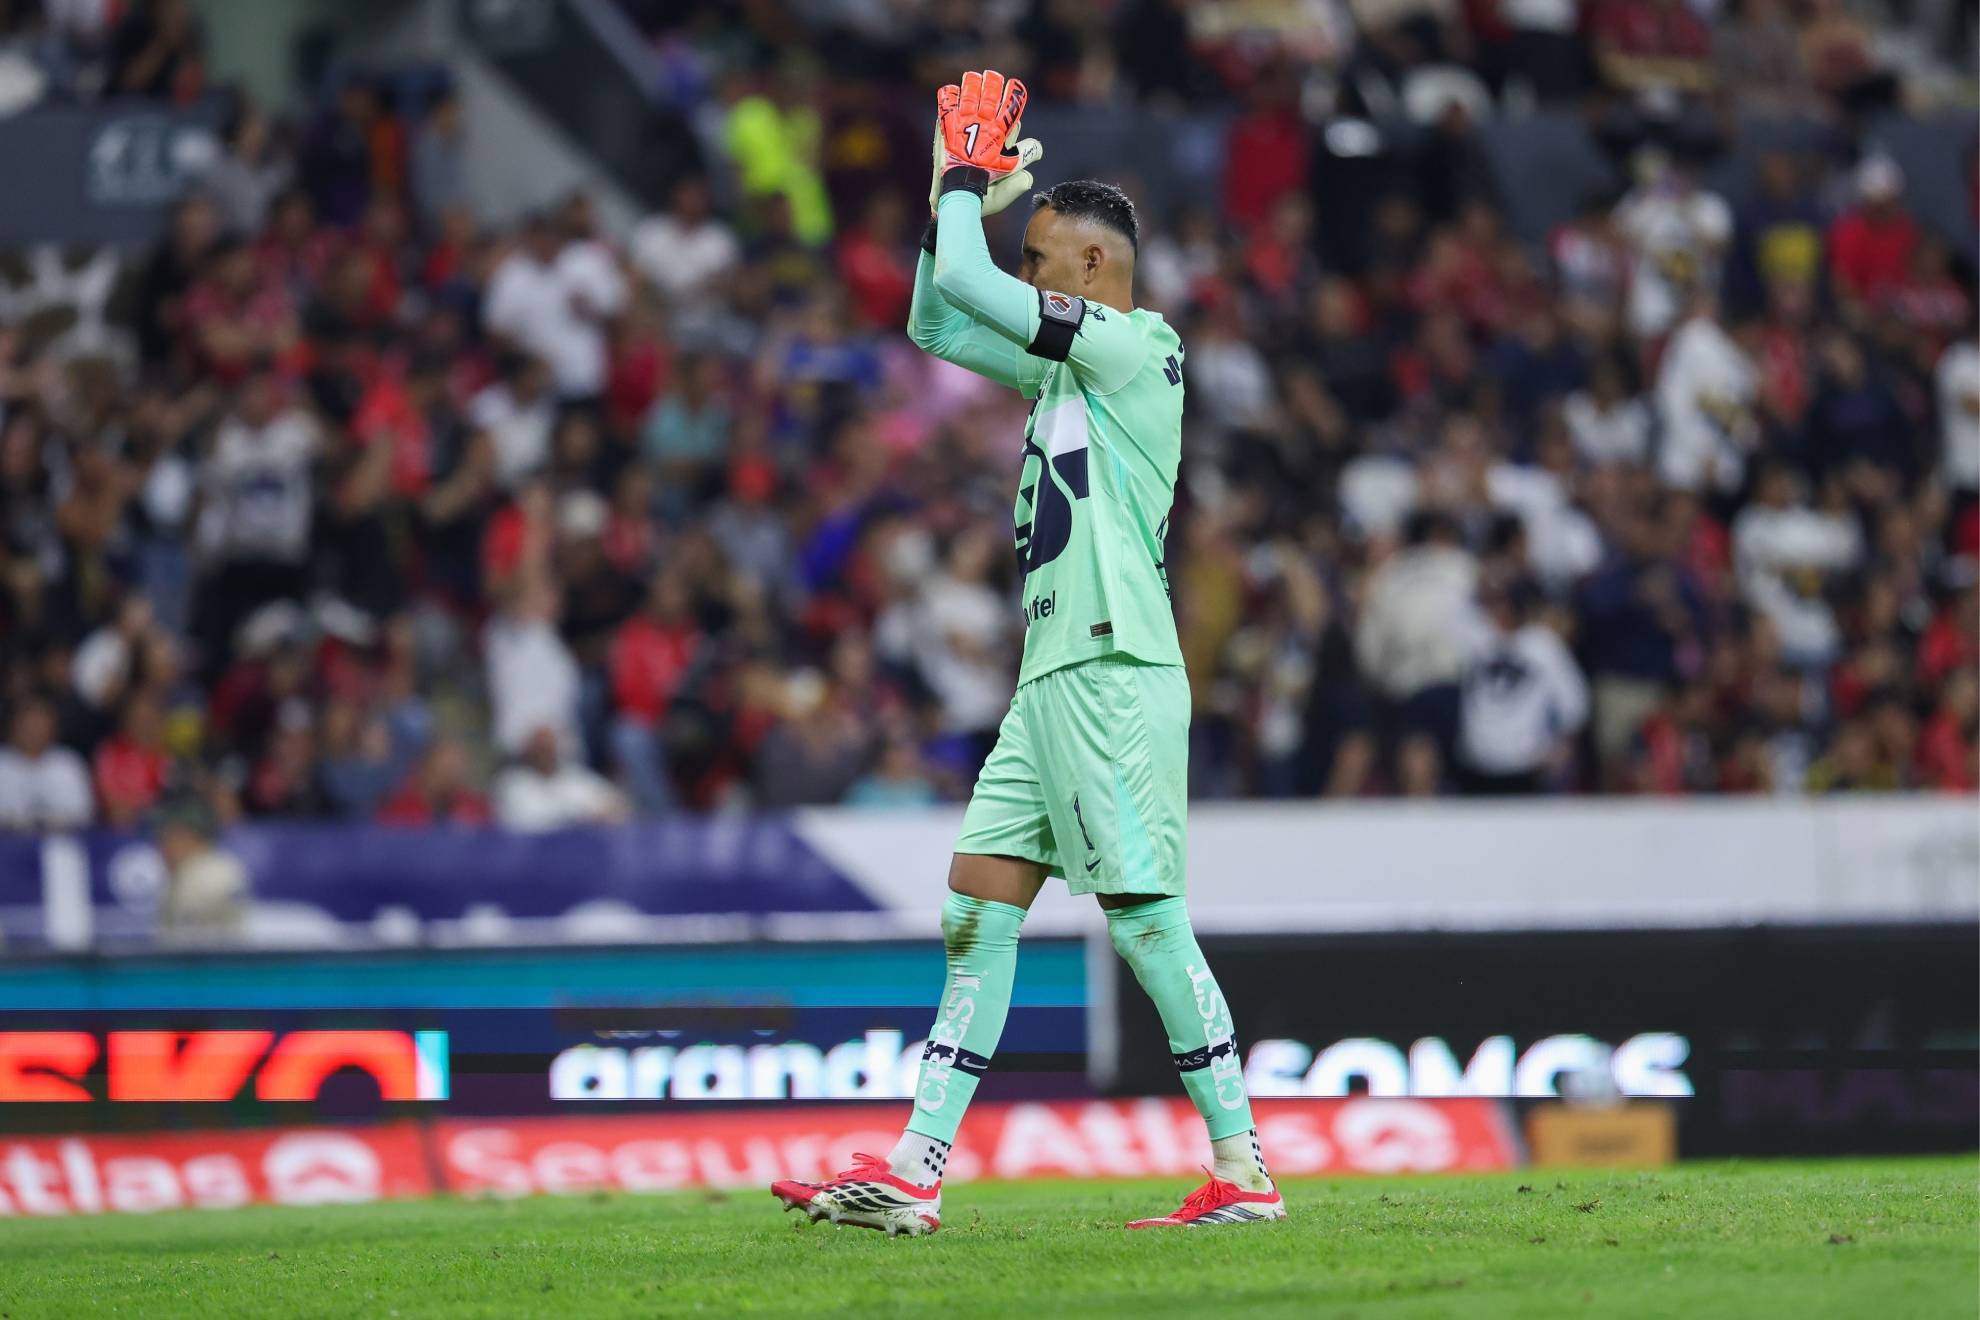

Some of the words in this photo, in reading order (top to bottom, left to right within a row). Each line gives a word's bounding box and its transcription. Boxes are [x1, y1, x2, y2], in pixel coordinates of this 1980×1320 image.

[1073, 791, 1096, 851] 1
[919, 967, 984, 1112] CREST
[1184, 963, 1245, 1111] CREST
[0, 1136, 251, 1217] tlas
